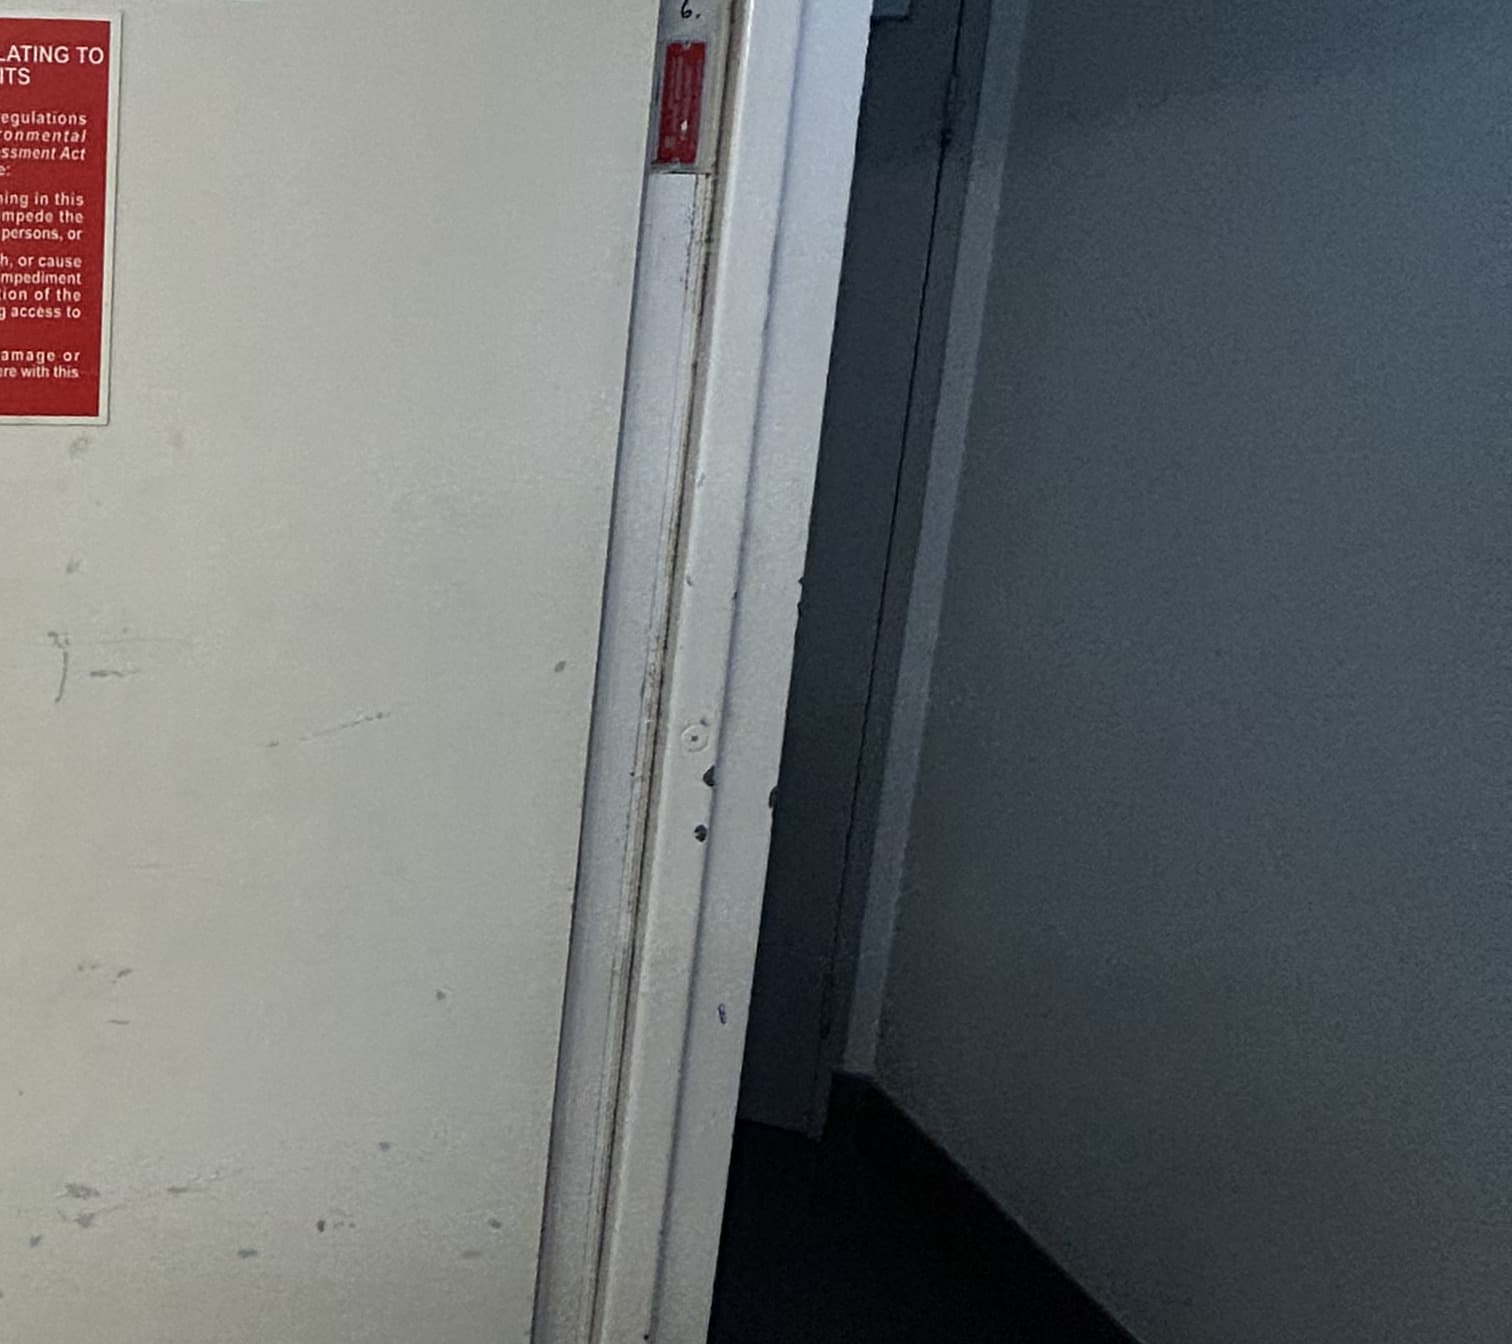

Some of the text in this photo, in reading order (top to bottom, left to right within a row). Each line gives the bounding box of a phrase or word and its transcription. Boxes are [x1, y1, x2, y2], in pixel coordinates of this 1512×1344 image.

[75, 46, 104, 65] TO
[59, 146, 86, 161] Act
[34, 192, 49, 206] in
[55, 192, 84, 206] this
[59, 210, 84, 223] the
[1, 228, 63, 242] persons,
[67, 229, 83, 240] or
[17, 256, 34, 267] or
[38, 256, 82, 268] cause
[34, 287, 50, 301] of
[56, 287, 81, 302] the
[11, 306, 62, 318] access
[66, 306, 81, 319] to
[63, 351, 80, 362] or
[20, 365, 50, 378] with
[53, 365, 79, 378] this
